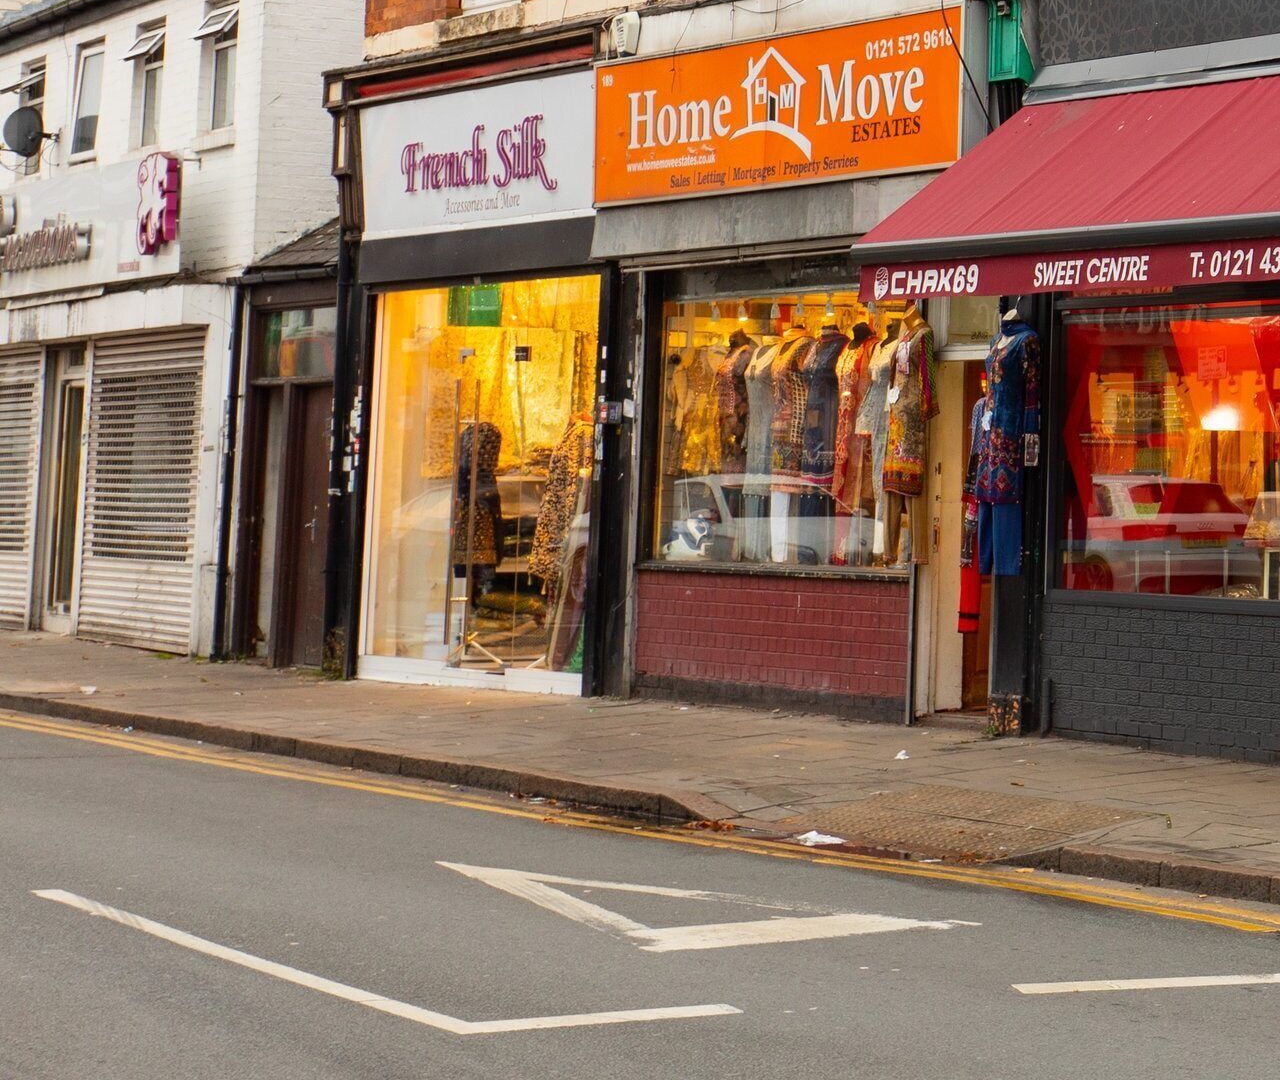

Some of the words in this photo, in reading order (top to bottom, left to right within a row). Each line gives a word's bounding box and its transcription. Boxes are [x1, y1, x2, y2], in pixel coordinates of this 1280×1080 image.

[866, 38, 894, 60] 0121
[898, 32, 920, 55] 572
[924, 26, 953, 50] 9618
[627, 90, 732, 150] Home
[816, 59, 925, 126] Move
[851, 115, 922, 143] ESTATES
[401, 125, 490, 193] French
[493, 114, 558, 191] Silk
[626, 151, 716, 172] www.homemoveestates.co.uk
[670, 174, 691, 189] Sales
[697, 170, 726, 187] Letting
[733, 164, 776, 183] Mortgages
[783, 159, 821, 177] Property
[823, 154, 859, 171] Services
[444, 197, 483, 217] Accessories
[485, 191, 500, 211] and
[500, 193, 520, 211] More
[891, 264, 979, 295] CHAK69
[1033, 258, 1083, 288] SWEET
[1086, 255, 1149, 284] CENTRE
[1190, 252, 1205, 279] T:
[1210, 248, 1254, 278] 0121
